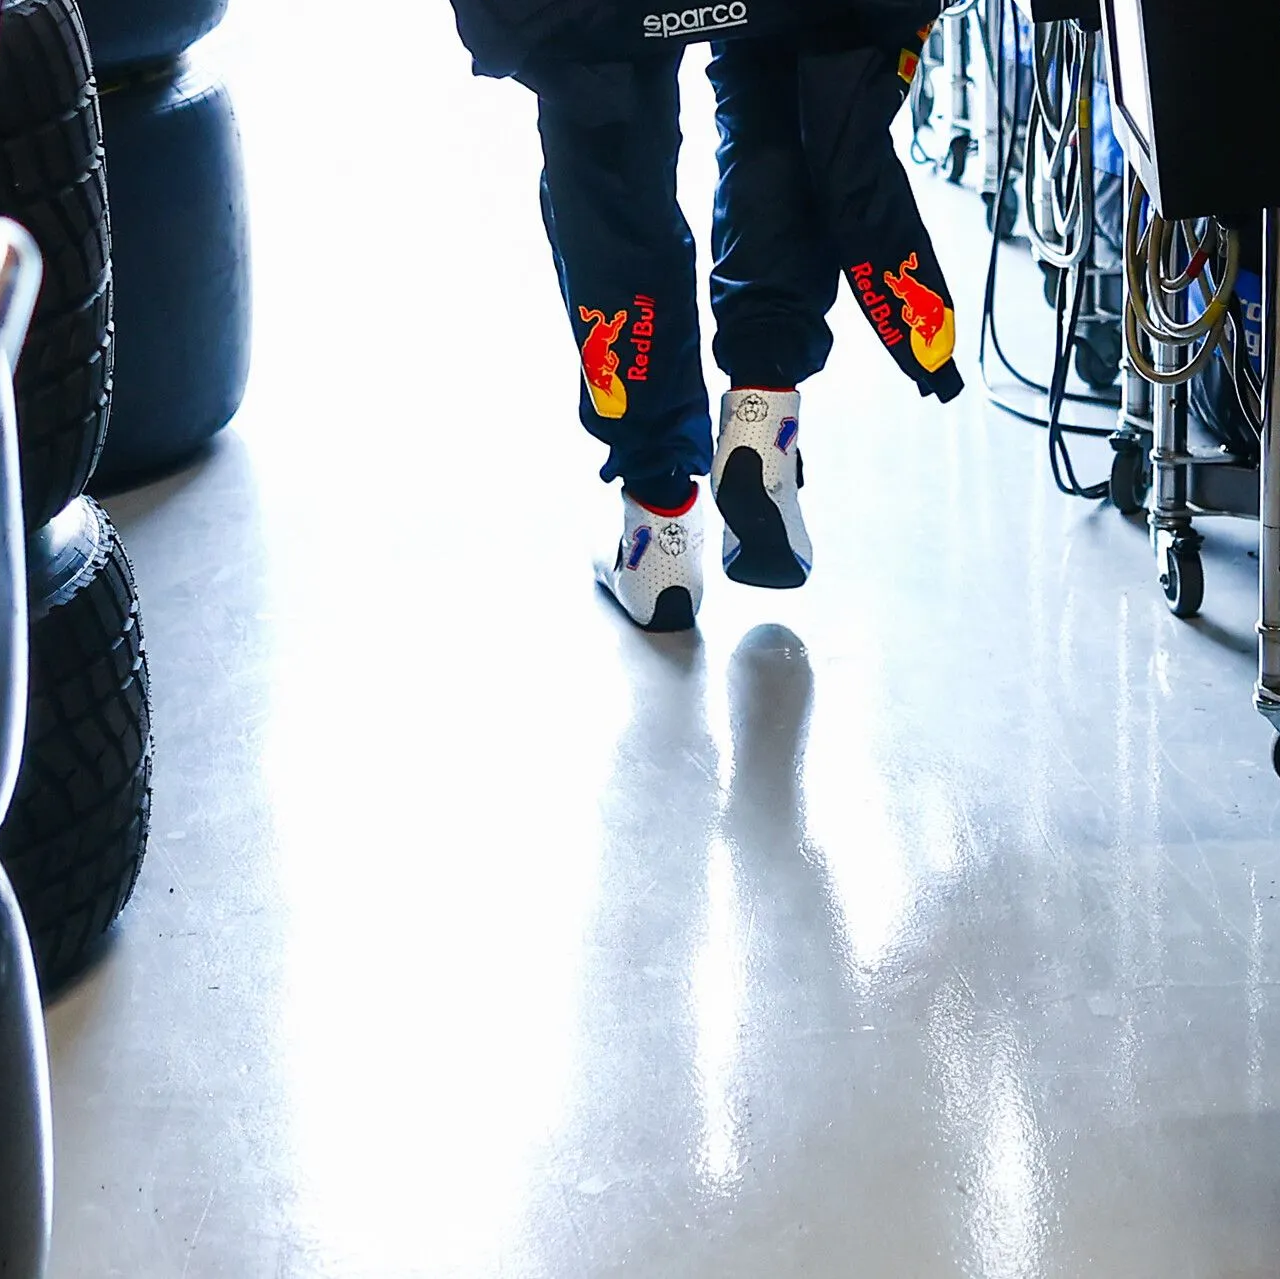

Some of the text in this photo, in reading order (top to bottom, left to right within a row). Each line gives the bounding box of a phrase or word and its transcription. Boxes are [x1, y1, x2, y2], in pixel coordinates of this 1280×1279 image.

[643, 1, 748, 38] sparco
[627, 294, 656, 381] Red Bull
[850, 261, 904, 346] Red Bull
